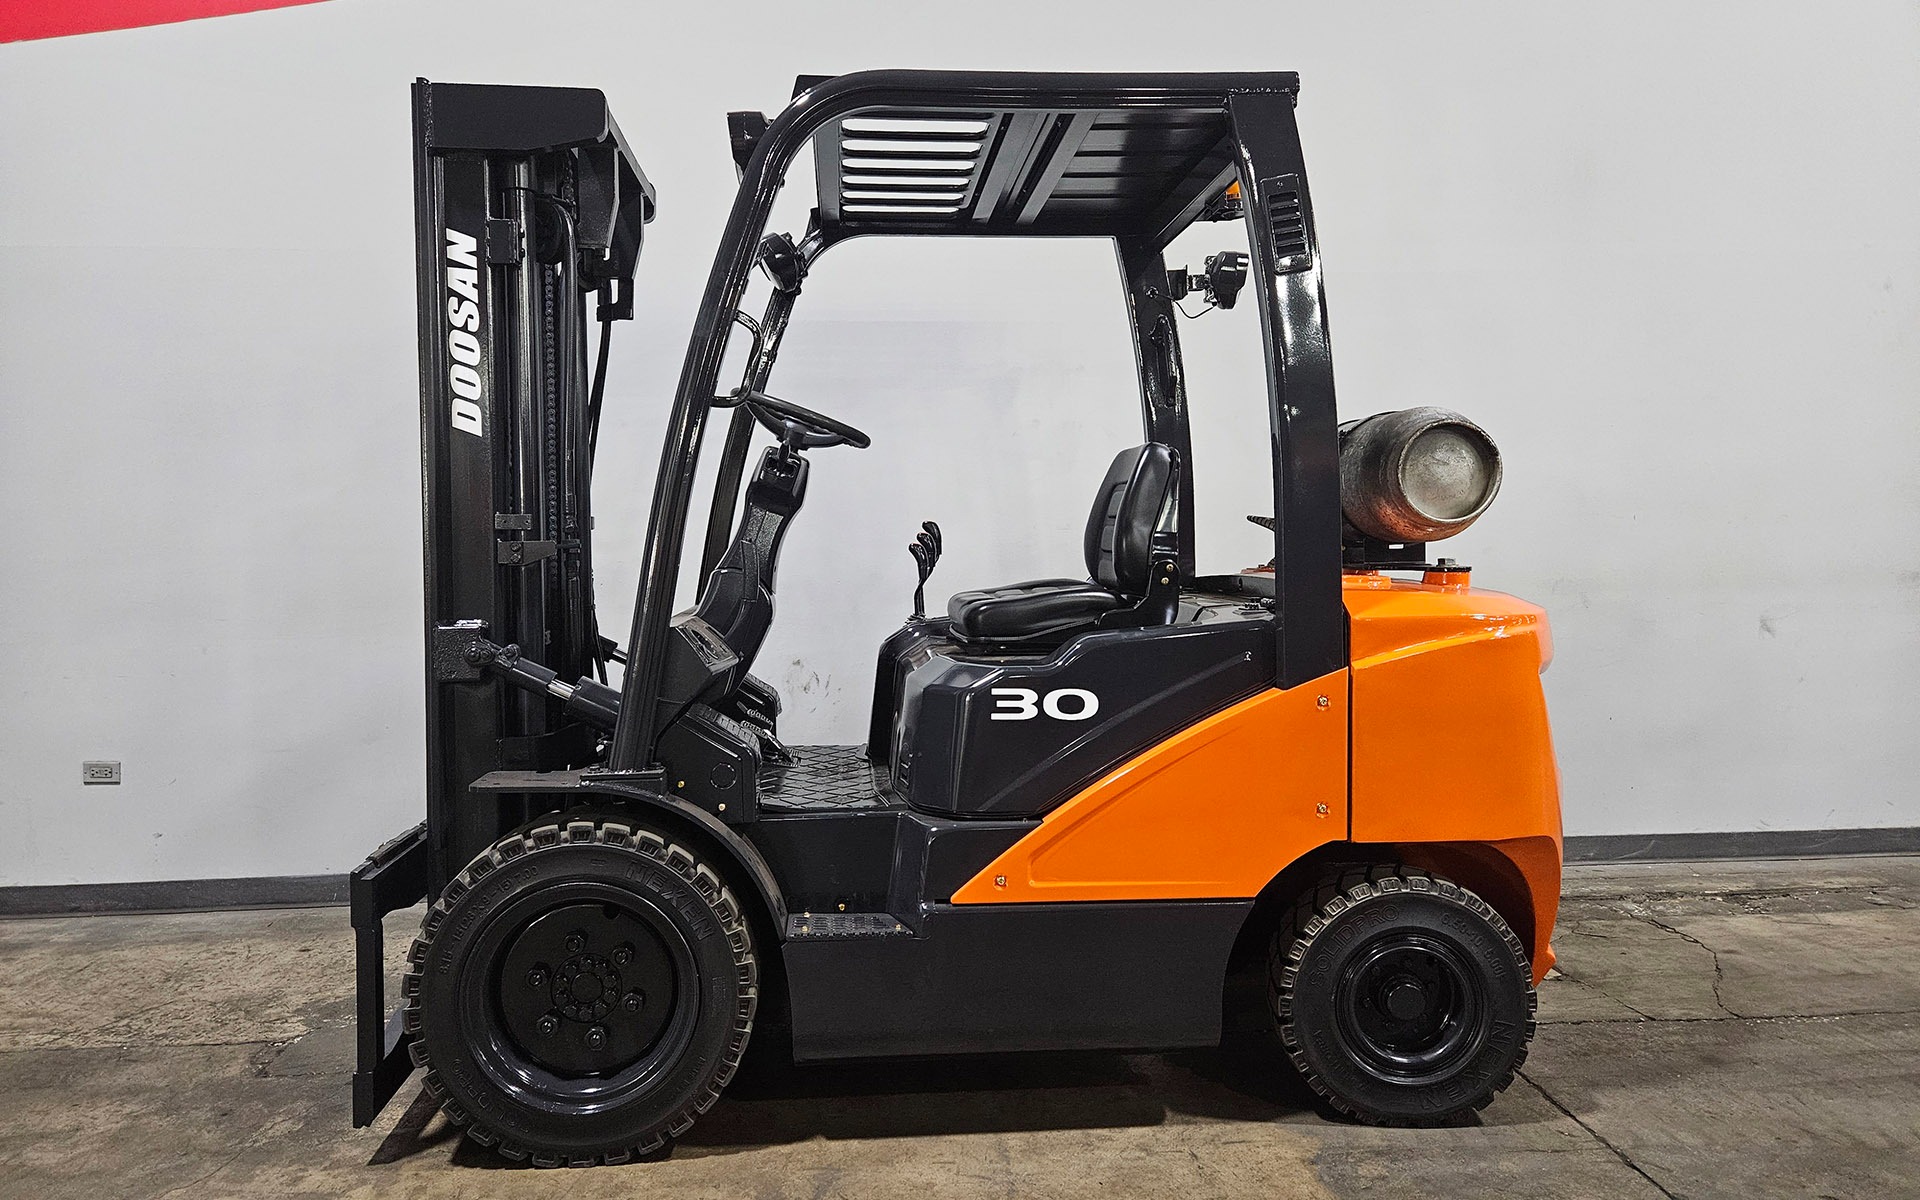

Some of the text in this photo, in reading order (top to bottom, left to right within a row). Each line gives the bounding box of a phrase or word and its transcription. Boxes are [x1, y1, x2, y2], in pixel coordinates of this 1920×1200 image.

[445, 227, 483, 438] DOOSAN
[990, 687, 1099, 721] 30
[623, 859, 714, 941] NEXEN
[1309, 904, 1400, 986] SOLIDPRO
[1420, 1018, 1517, 1110] NEXEN
